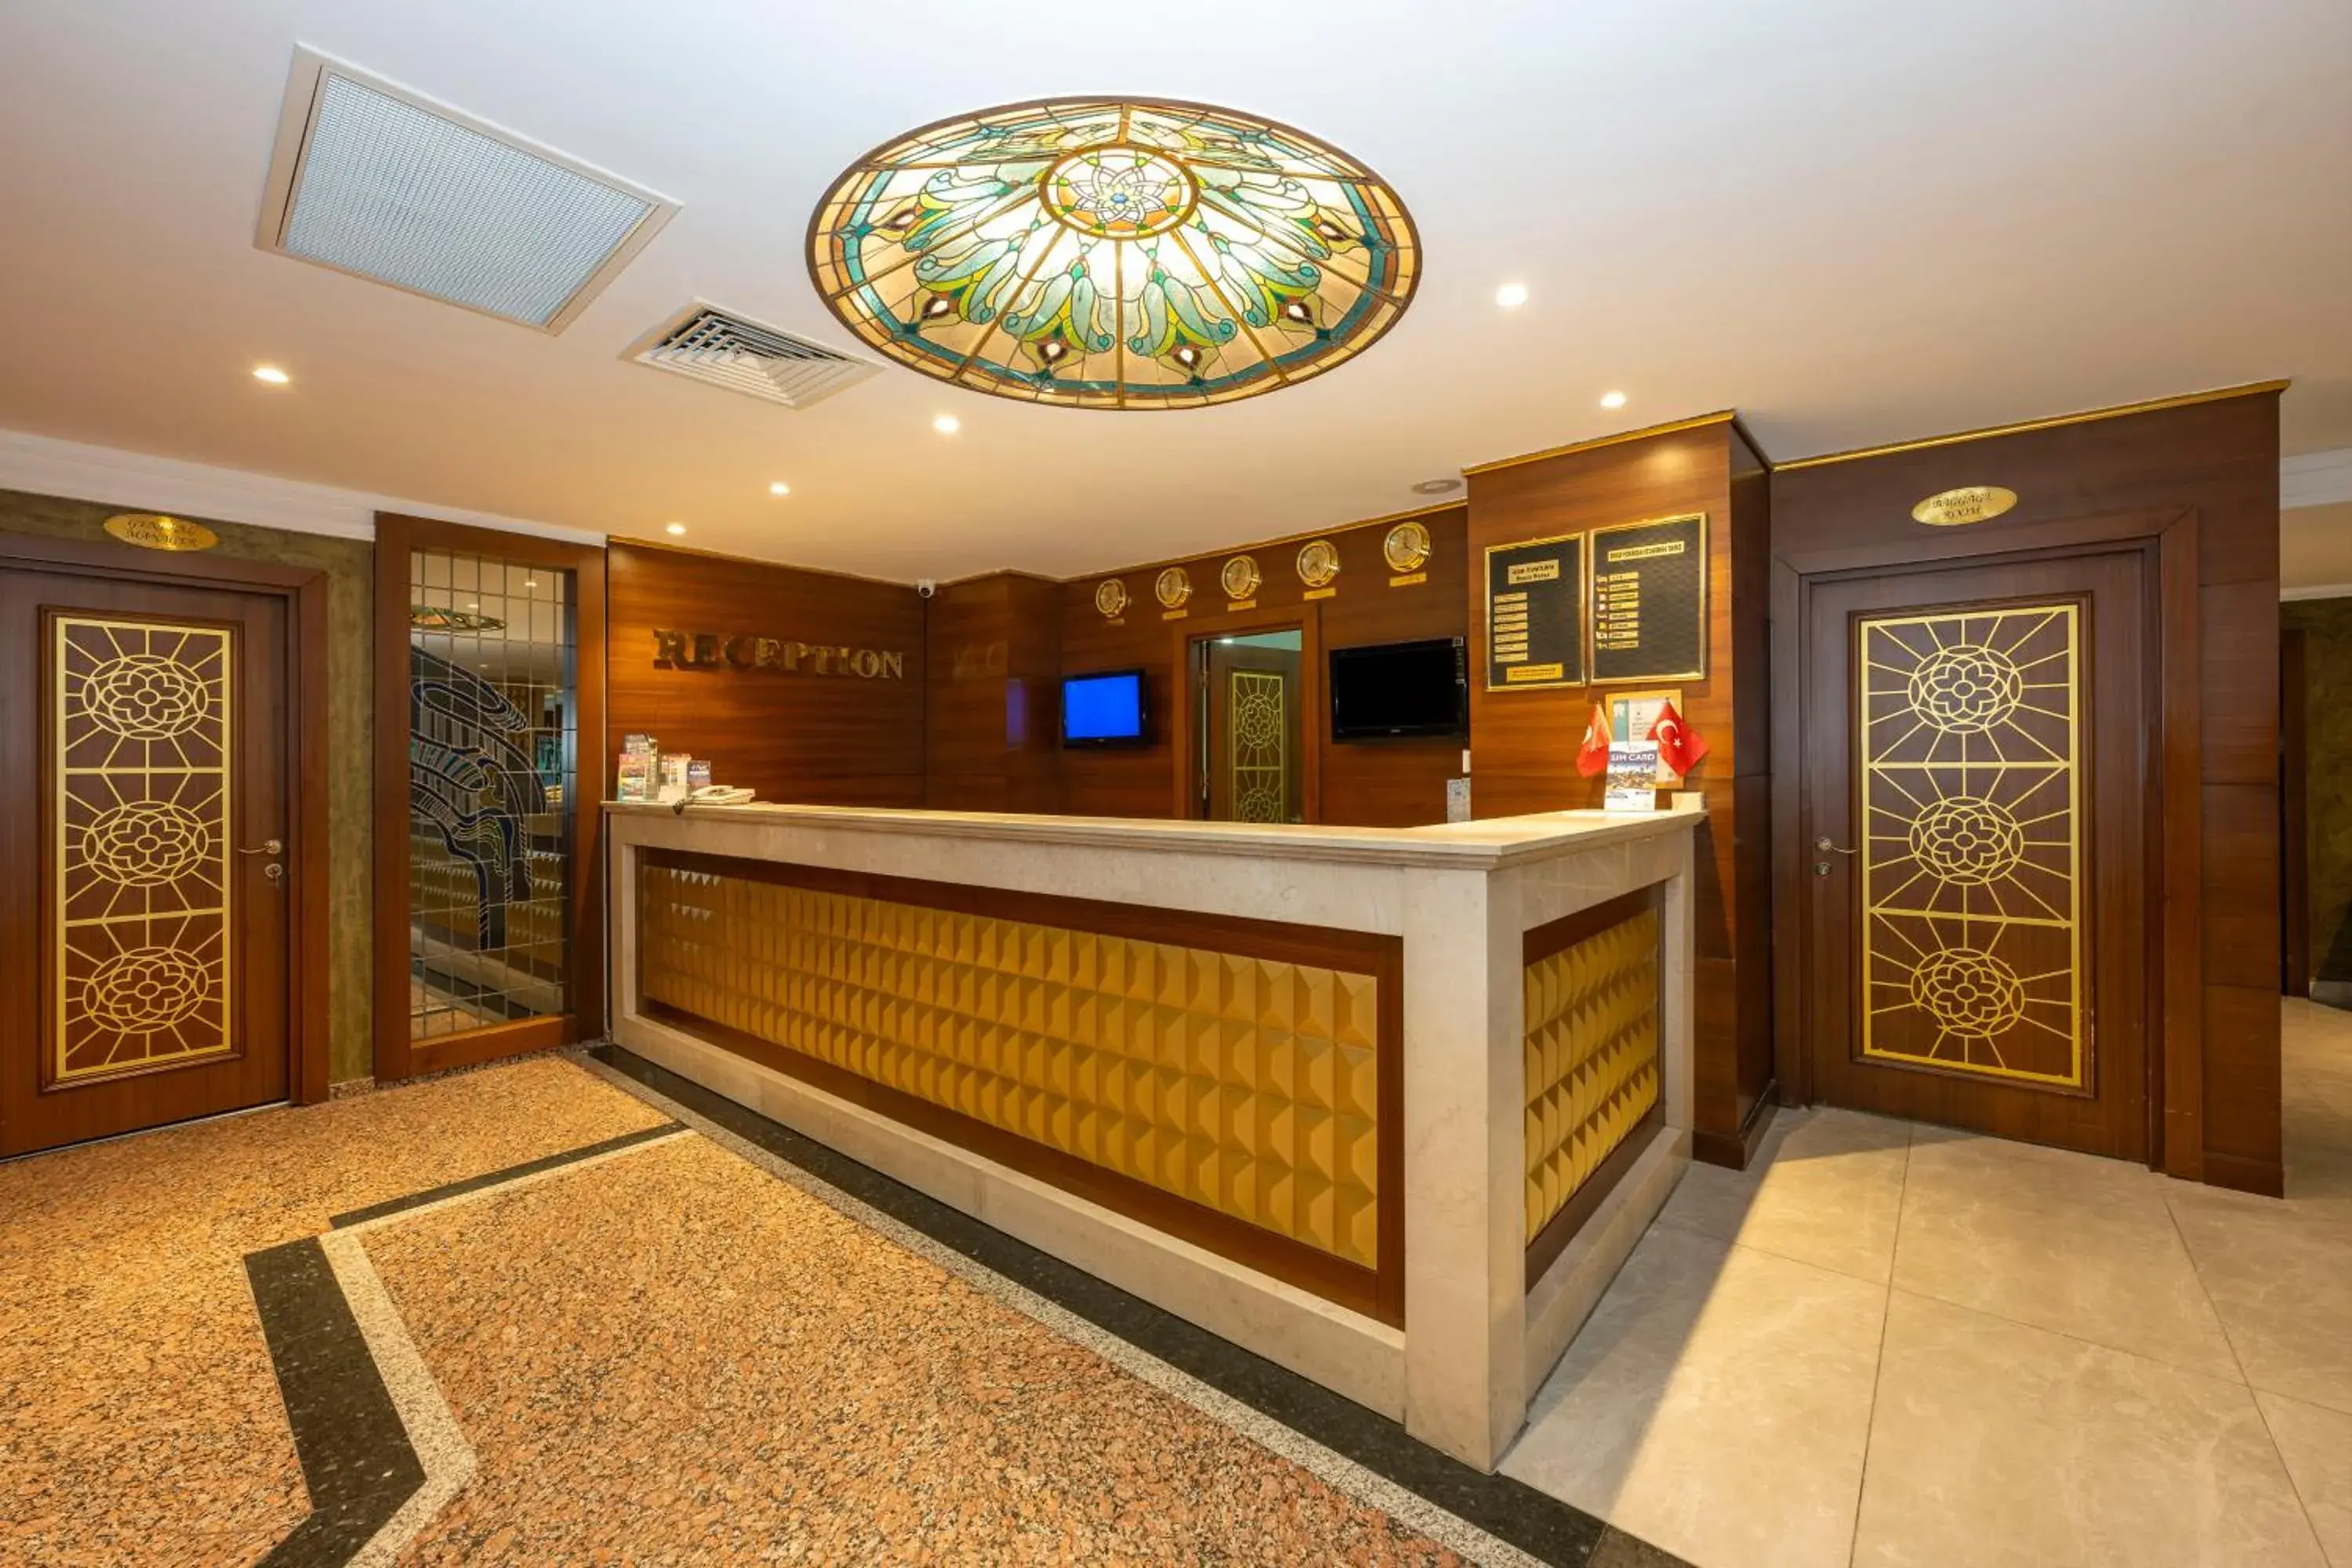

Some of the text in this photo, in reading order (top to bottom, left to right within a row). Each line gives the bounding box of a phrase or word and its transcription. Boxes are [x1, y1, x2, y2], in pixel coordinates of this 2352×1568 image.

[653, 627, 903, 679] RECEPTION
[1610, 753, 1655, 761] SIM CARD
